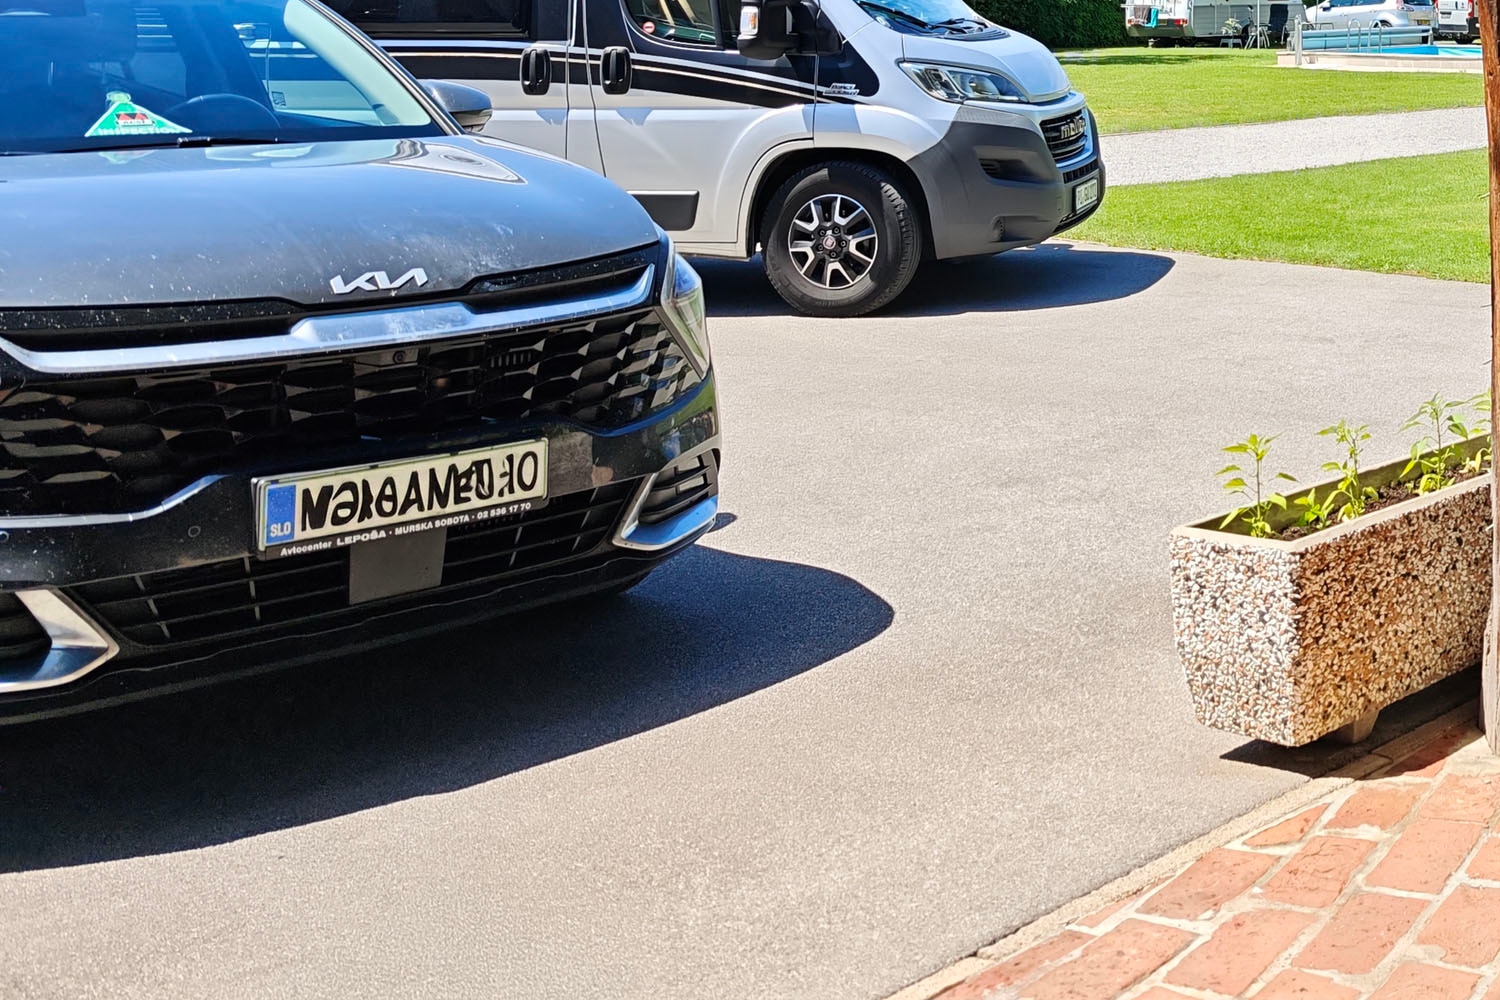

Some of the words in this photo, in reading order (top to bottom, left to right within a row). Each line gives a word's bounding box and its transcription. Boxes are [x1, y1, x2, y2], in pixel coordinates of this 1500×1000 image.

[329, 267, 428, 295] KIA
[270, 521, 292, 537] SLO
[280, 541, 333, 557] Avtocenter
[336, 529, 387, 546] LEPOŠA
[394, 521, 434, 535] MURSKA
[434, 513, 470, 528] SOBOTA
[477, 510, 489, 520] 02
[508, 504, 519, 513] 17
[520, 502, 532, 511] 70
